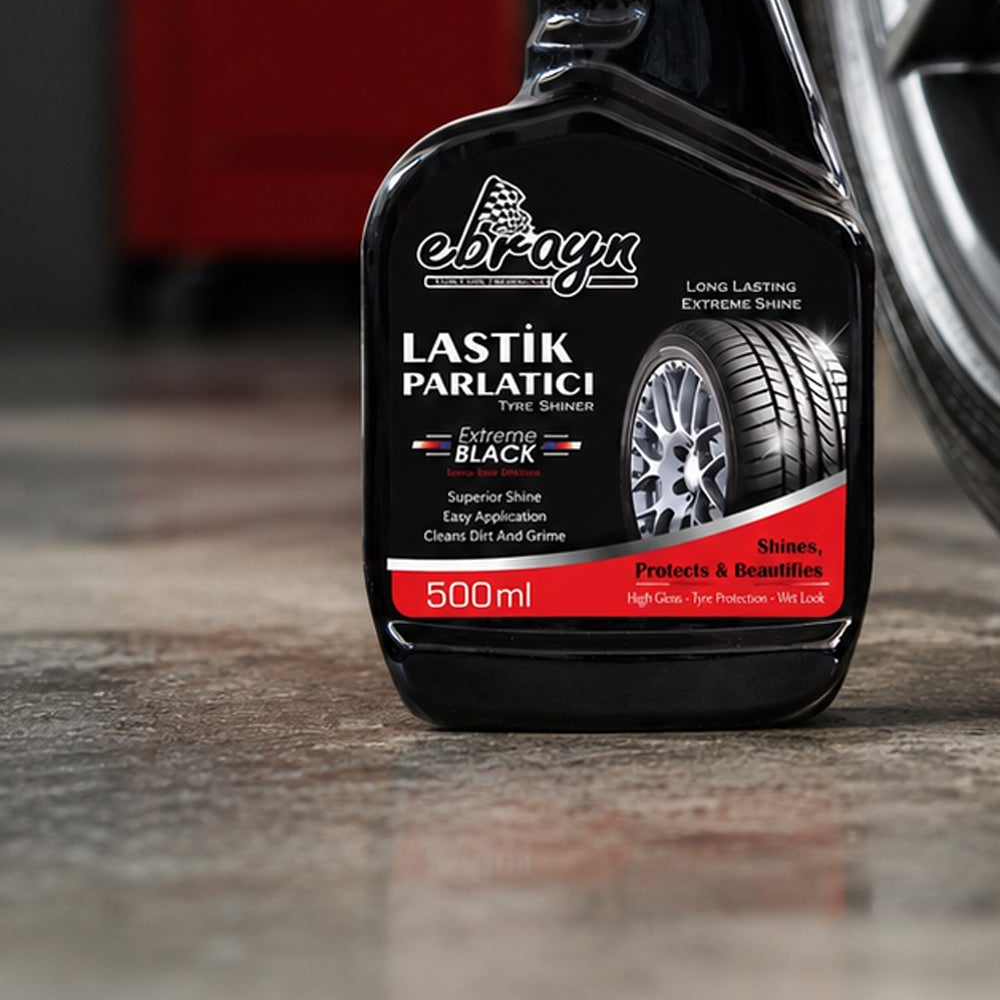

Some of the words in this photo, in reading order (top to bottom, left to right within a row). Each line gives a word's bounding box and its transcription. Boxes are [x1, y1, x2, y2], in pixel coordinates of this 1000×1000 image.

[417, 175, 640, 297] ebrayn
[403, 323, 573, 363] LASTİK
[403, 372, 594, 395] PARLATICI
[458, 427, 538, 443] Extreme
[454, 445, 537, 463] BLACK
[447, 490, 502, 505] Superior
[505, 490, 542, 503] Shine
[474, 510, 547, 524] Application
[423, 530, 466, 542] Cleans
[469, 530, 493, 542] Dirt
[496, 530, 523, 542] And
[526, 529, 566, 542] Grime
[757, 538, 823, 556] Shines,
[635, 562, 710, 578] Protects
[716, 562, 729, 578] &
[735, 562, 823, 578] Beautifies
[627, 591, 652, 608] High
[691, 591, 713, 607] Tyre
[715, 592, 768, 604] Protection
[800, 591, 825, 604] Look
